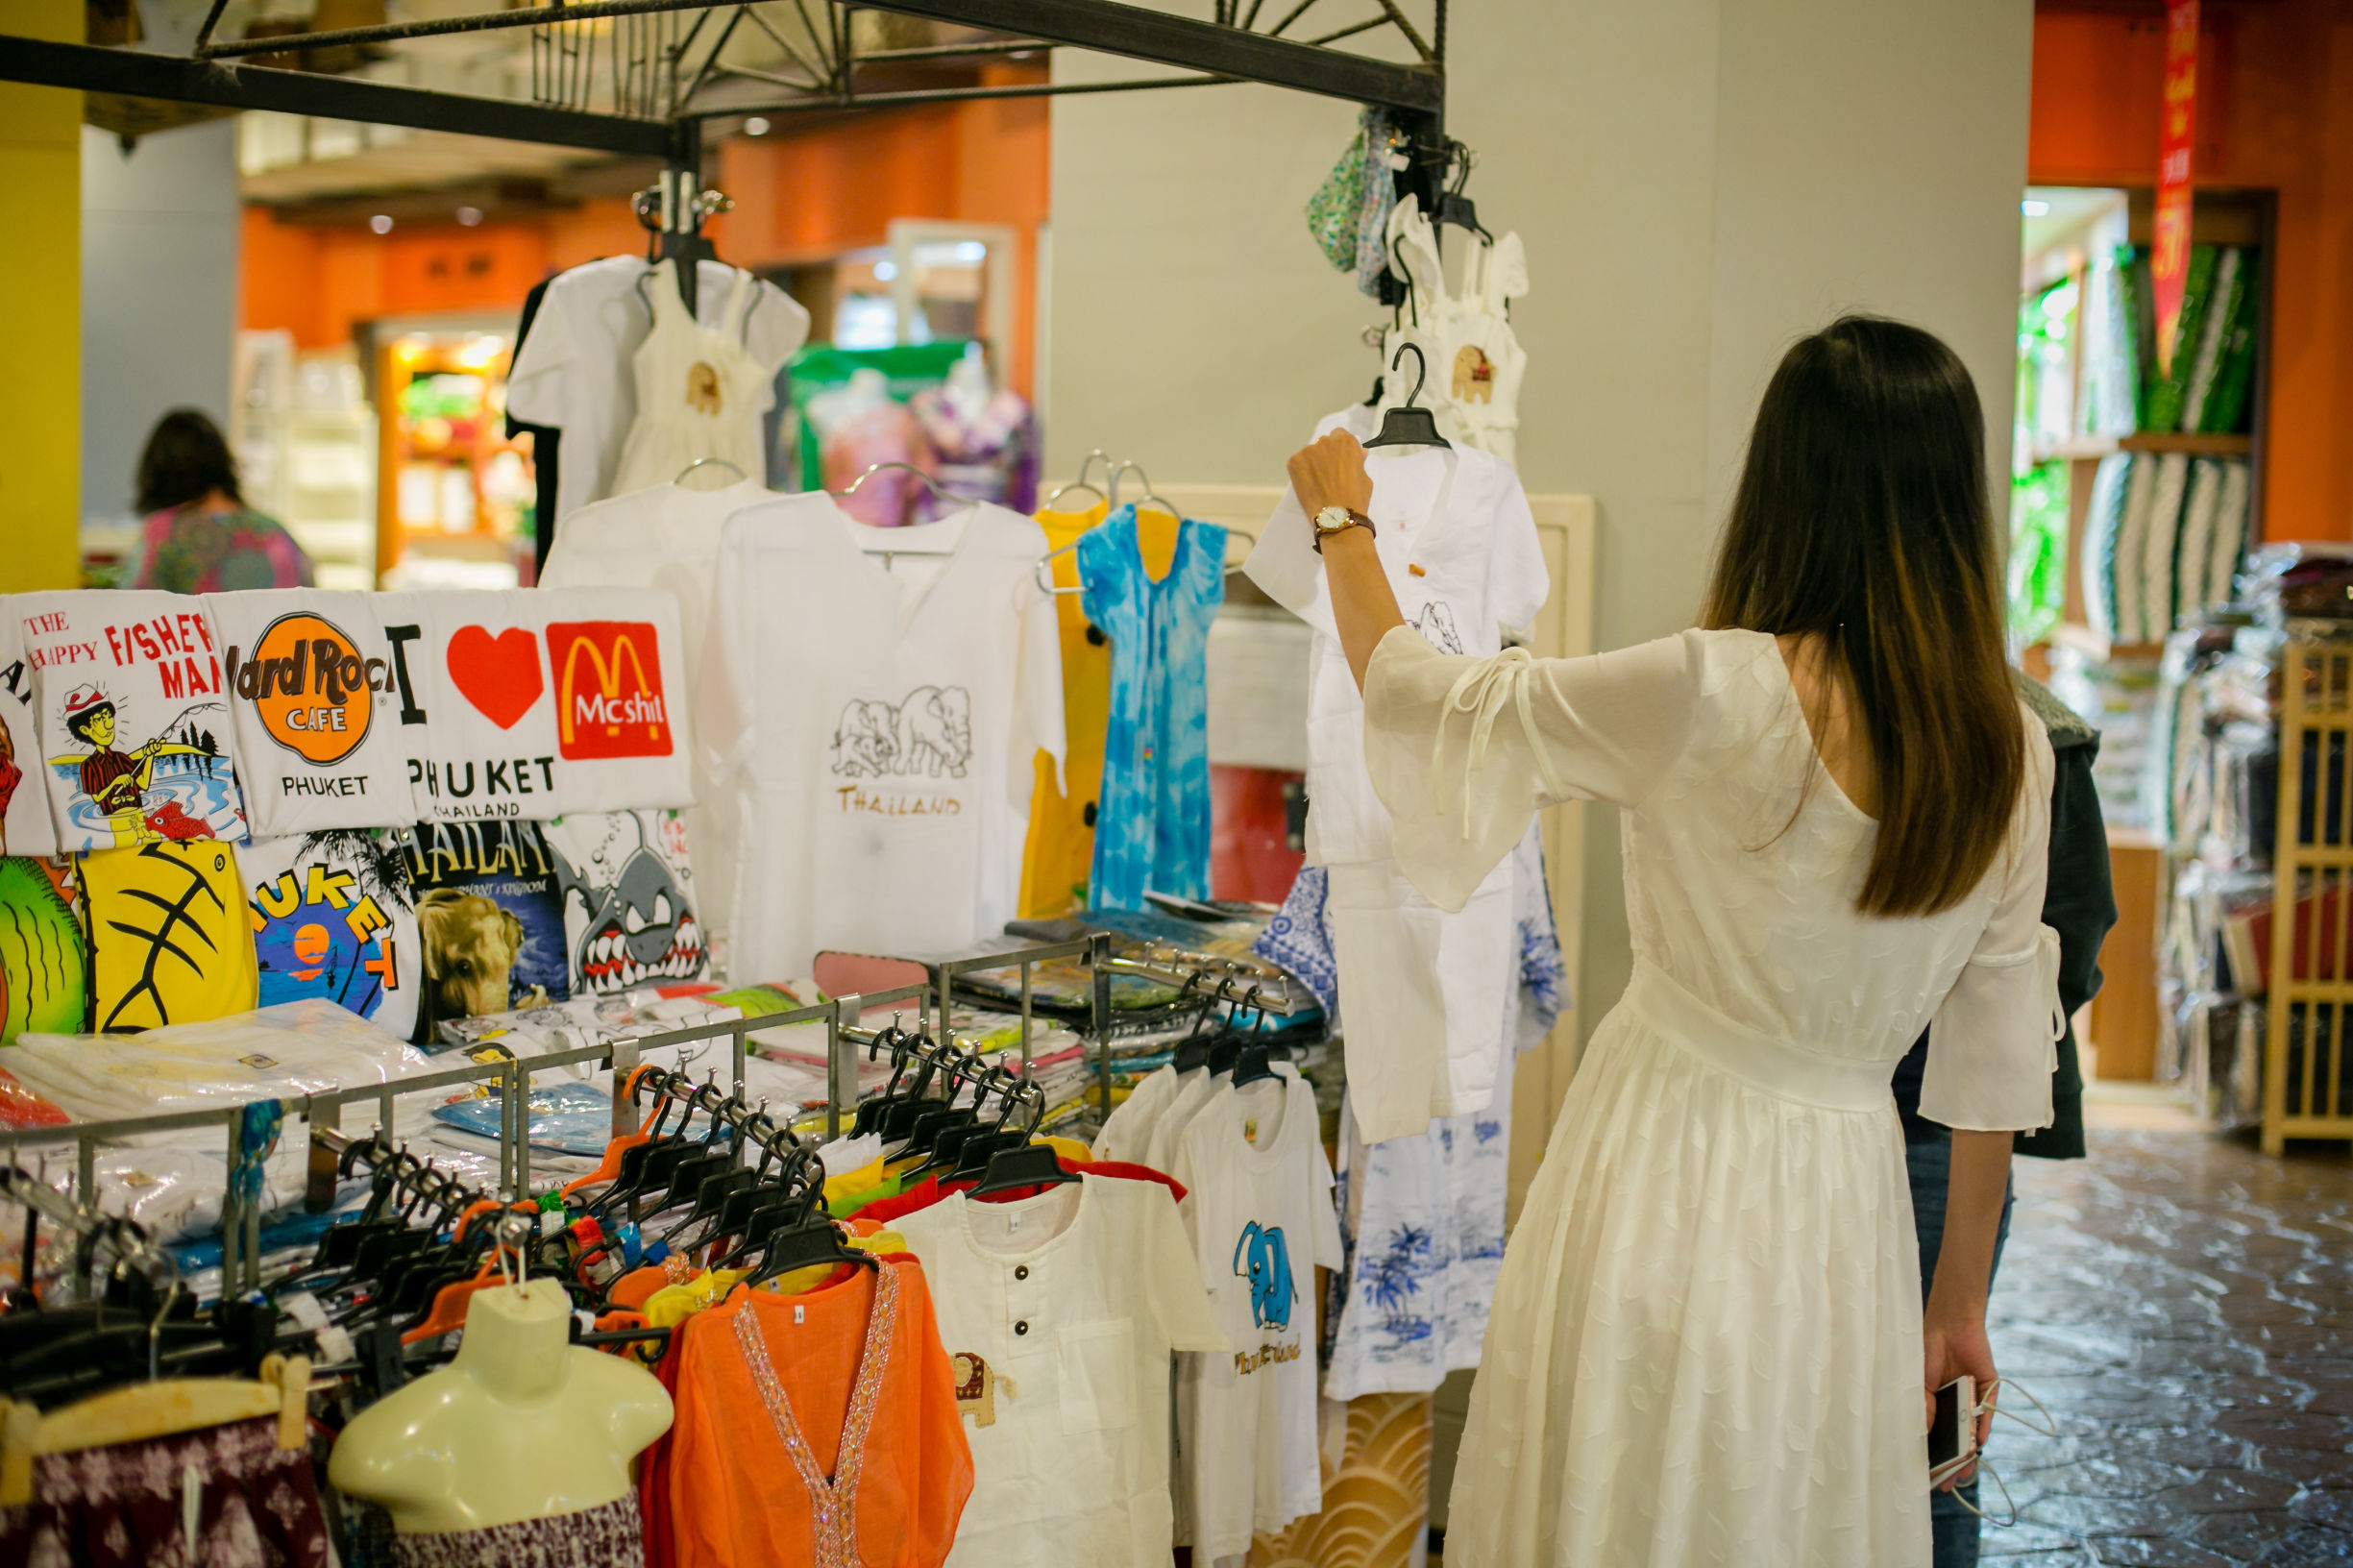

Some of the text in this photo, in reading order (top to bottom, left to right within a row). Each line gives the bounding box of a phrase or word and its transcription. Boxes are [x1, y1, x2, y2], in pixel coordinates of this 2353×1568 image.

[24, 611, 69, 636] THE
[29, 641, 98, 672] HAPPY
[385, 625, 427, 724] I
[286, 707, 347, 732] CAFE
[282, 775, 369, 797] PHUKET
[835, 784, 961, 817] THAILAND
[394, 821, 556, 884] HAILAN
